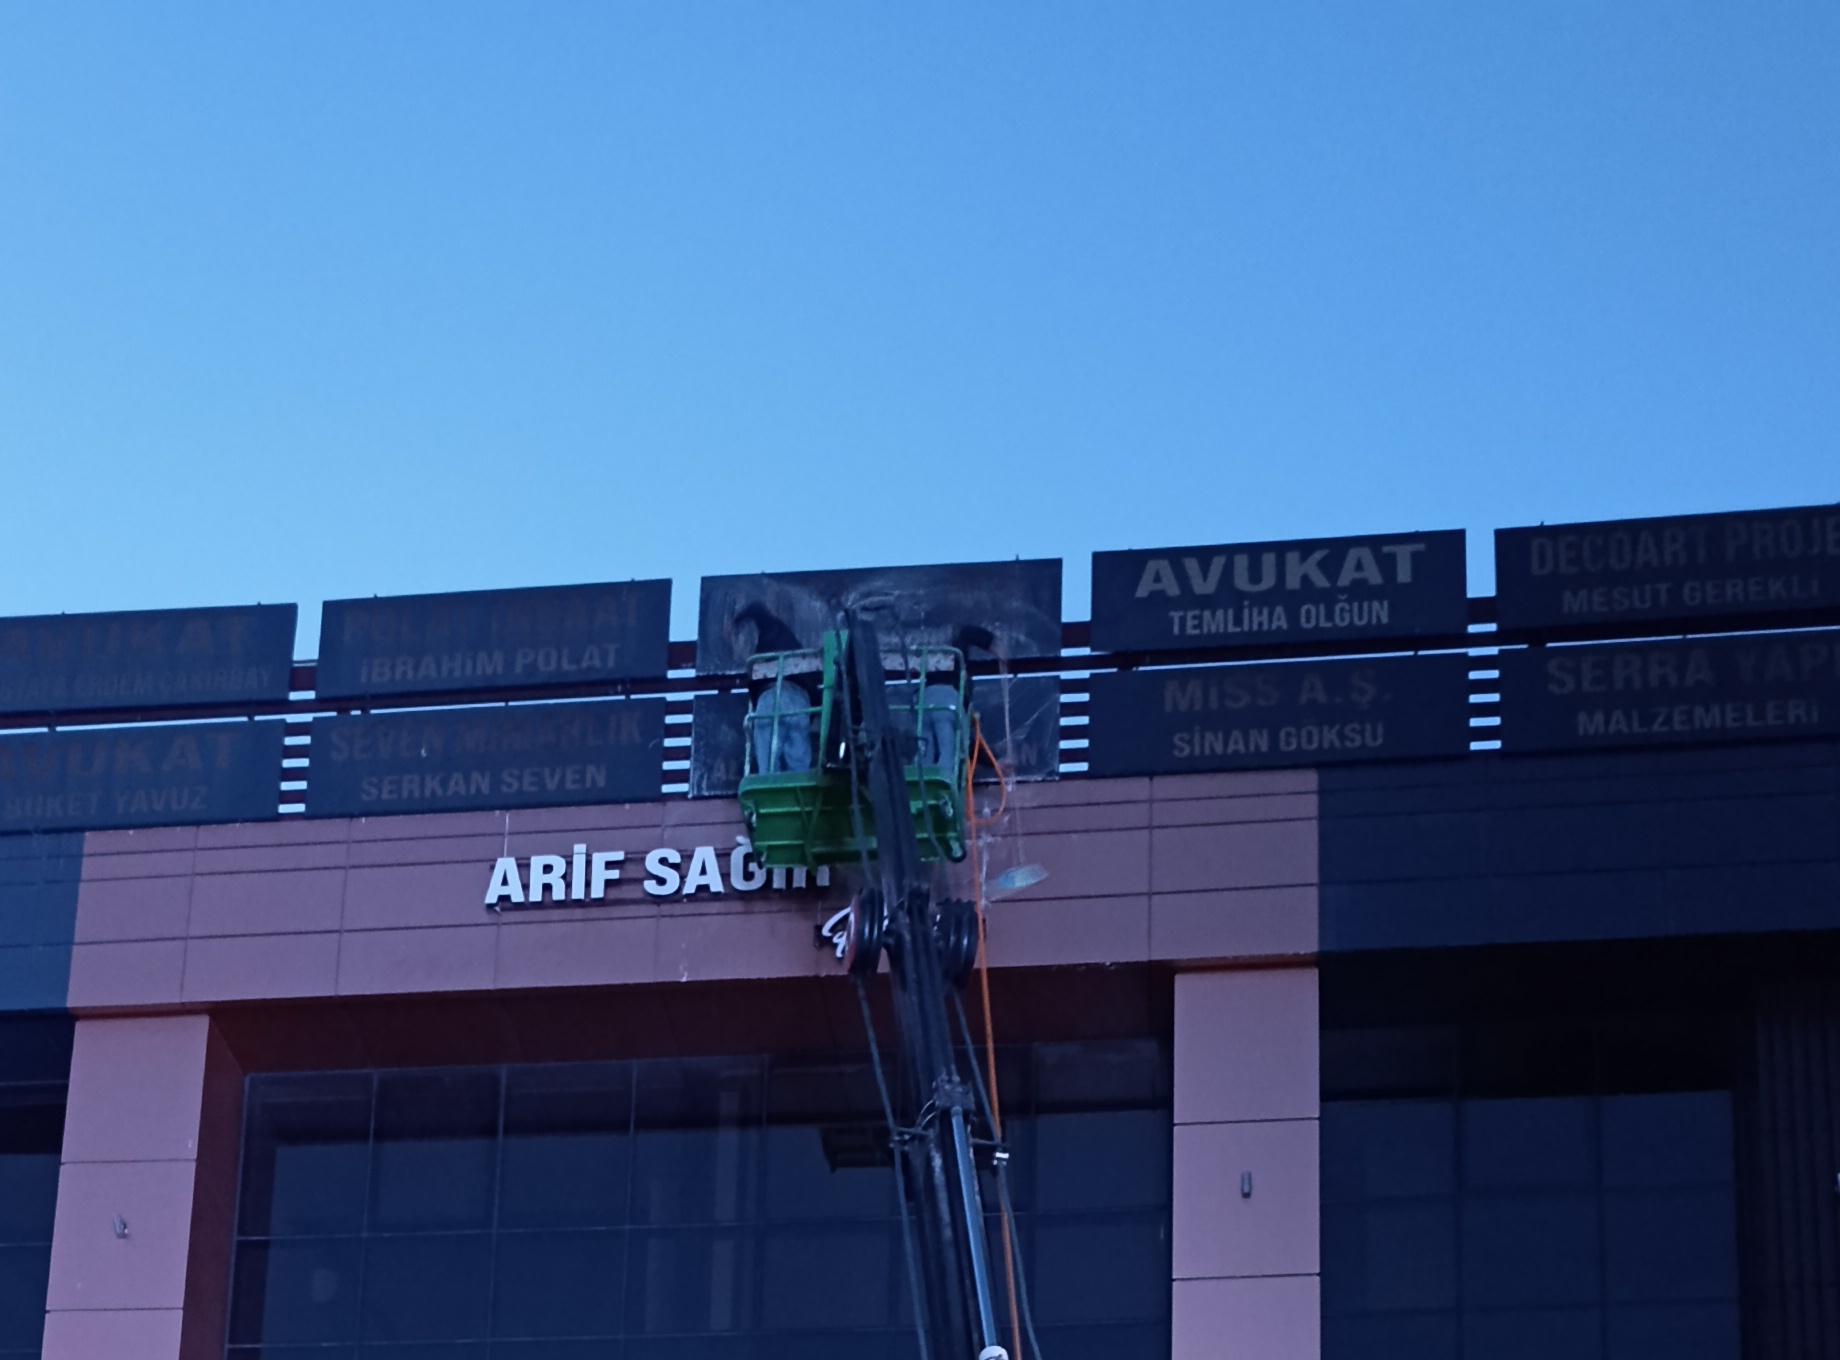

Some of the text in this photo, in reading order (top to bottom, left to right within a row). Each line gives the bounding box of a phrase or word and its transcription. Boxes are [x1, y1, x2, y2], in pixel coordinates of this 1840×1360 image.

[1135, 543, 1426, 598] AVUKAT
[1169, 595, 1389, 636] TEMLİHA OLĞUN
[1561, 583, 1672, 614] MESUT
[515, 643, 621, 671] POLAT
[1547, 647, 1714, 696] SERRA
[1173, 726, 1269, 758] SİNAN
[113, 785, 209, 814] YAVUZ
[361, 763, 608, 802] SERKAN SEVEN
[484, 843, 625, 906] ARİF
